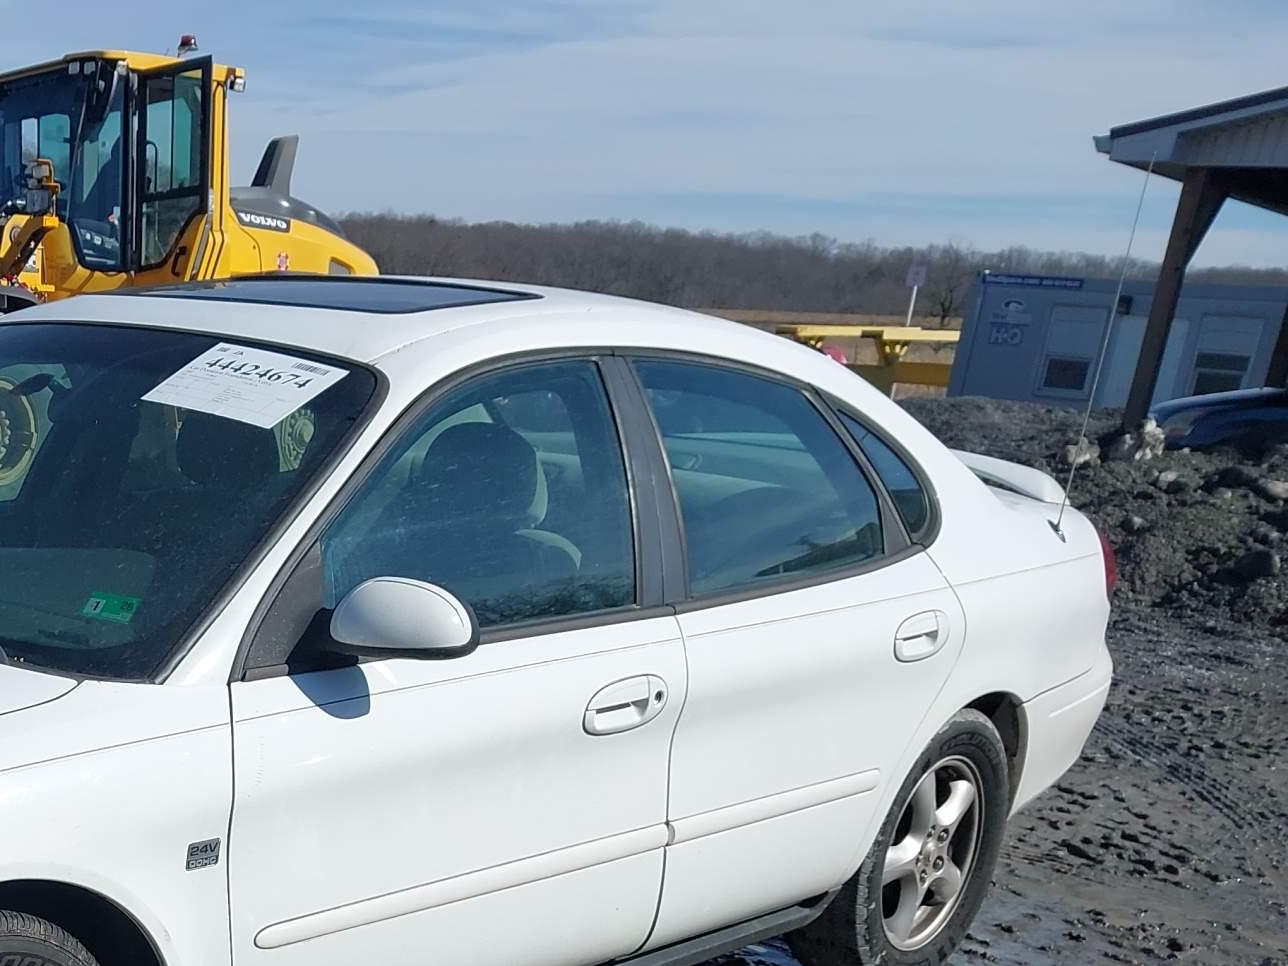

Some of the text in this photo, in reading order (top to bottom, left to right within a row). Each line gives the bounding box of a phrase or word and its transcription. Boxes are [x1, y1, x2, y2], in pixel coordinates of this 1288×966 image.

[238, 212, 288, 229] VOLVO
[205, 357, 314, 389] 44424674
[190, 842, 218, 857] 24V
[189, 856, 217, 868] DOHC
